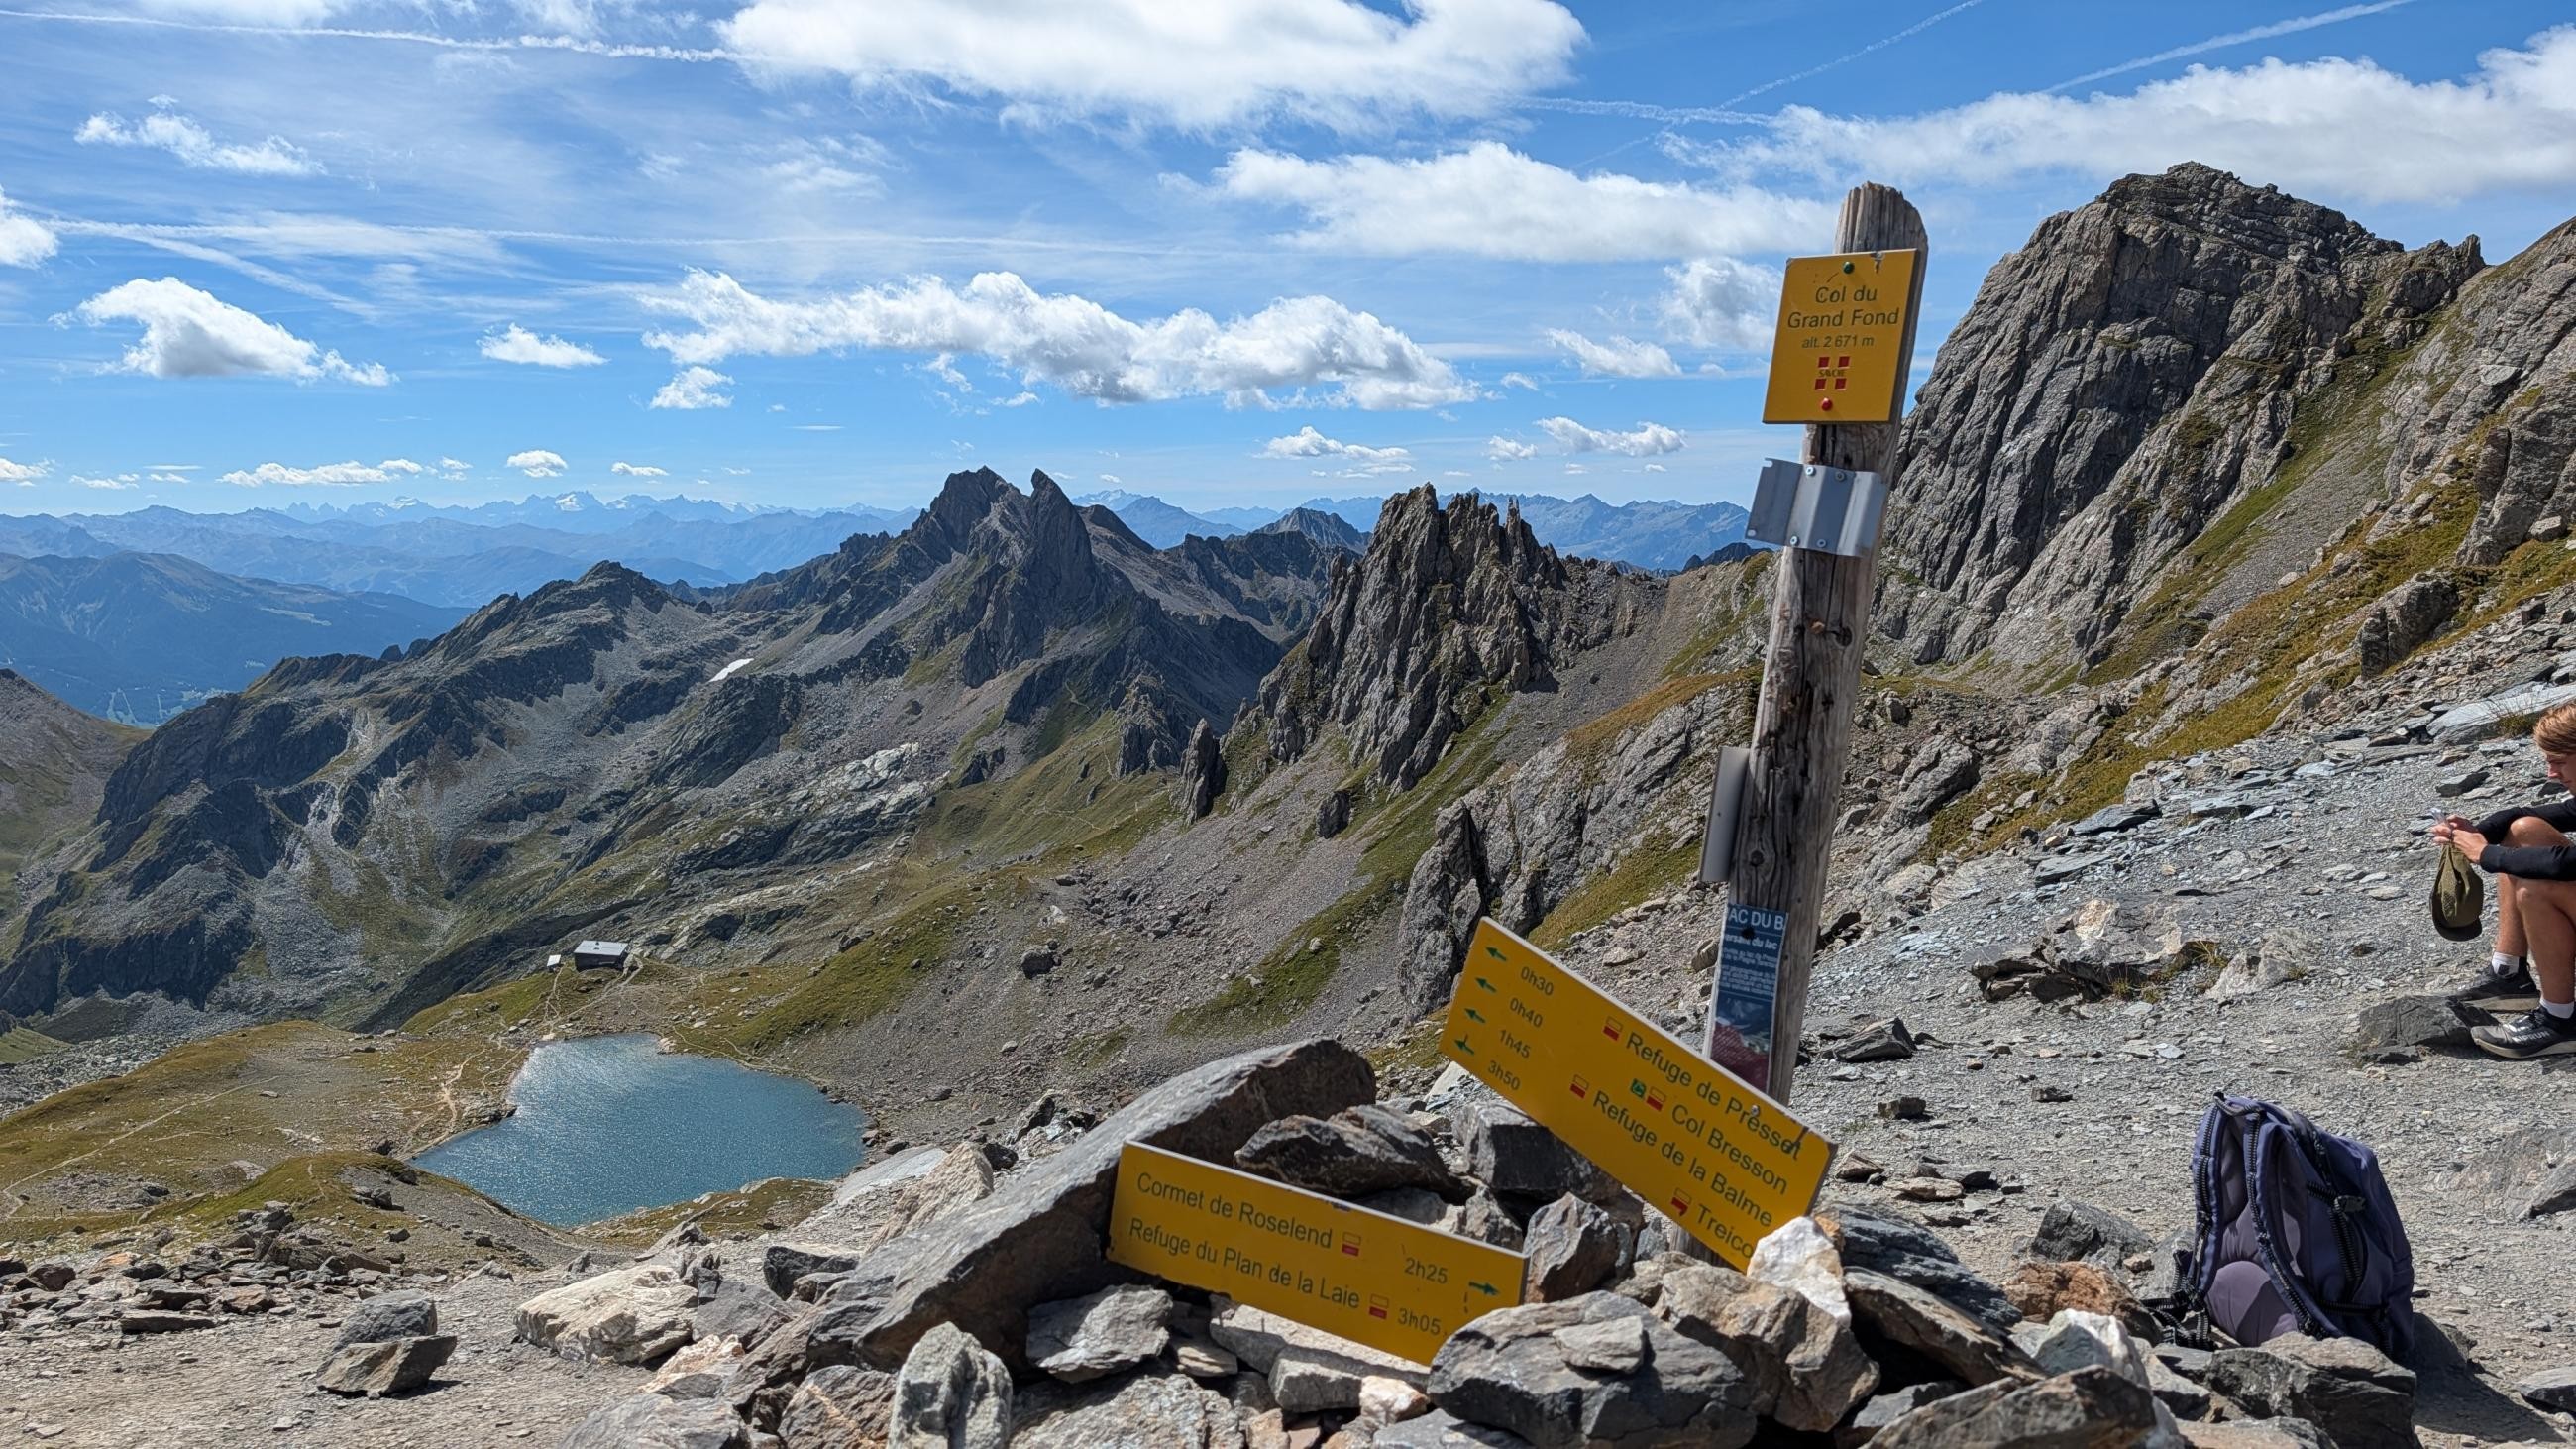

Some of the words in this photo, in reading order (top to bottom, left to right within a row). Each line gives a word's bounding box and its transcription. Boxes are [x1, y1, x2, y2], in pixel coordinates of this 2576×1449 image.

[1815, 286, 1846, 303] Col
[1853, 285, 1878, 302] du
[1787, 310, 1844, 328] Grand
[1851, 307, 1900, 325] Fond
[1834, 334, 1857, 348] 671
[1861, 337, 1875, 347] m
[1751, 911, 1771, 928] DU
[1521, 966, 1554, 996] 0h30
[1510, 997, 1543, 1028] 0h40
[1500, 1029, 1531, 1059] 1h45
[1488, 1060, 1521, 1091] 3h50
[1626, 1032, 1692, 1087] Refuge
[1696, 1082, 1721, 1106] de
[1593, 1091, 1658, 1146] Refuge
[1661, 1142, 1684, 1166] de
[1688, 1157, 1706, 1181] la
[1711, 1172, 1772, 1227] Balme
[1671, 1104, 1705, 1138] Col
[1707, 1128, 1787, 1195] Bresson
[1137, 1172, 1204, 1210] Cormet
[1210, 1194, 1233, 1218] de
[1239, 1201, 1333, 1249] Roselend
[1129, 1217, 1190, 1256] Refuge
[1196, 1240, 1218, 1264] du
[1223, 1247, 1263, 1279] Plan
[1269, 1264, 1291, 1286] de
[1297, 1270, 1313, 1294] la
[1320, 1277, 1360, 1308] Laie
[1404, 1257, 1448, 1284] 2h25
[1397, 1307, 1442, 1336] 3h05
